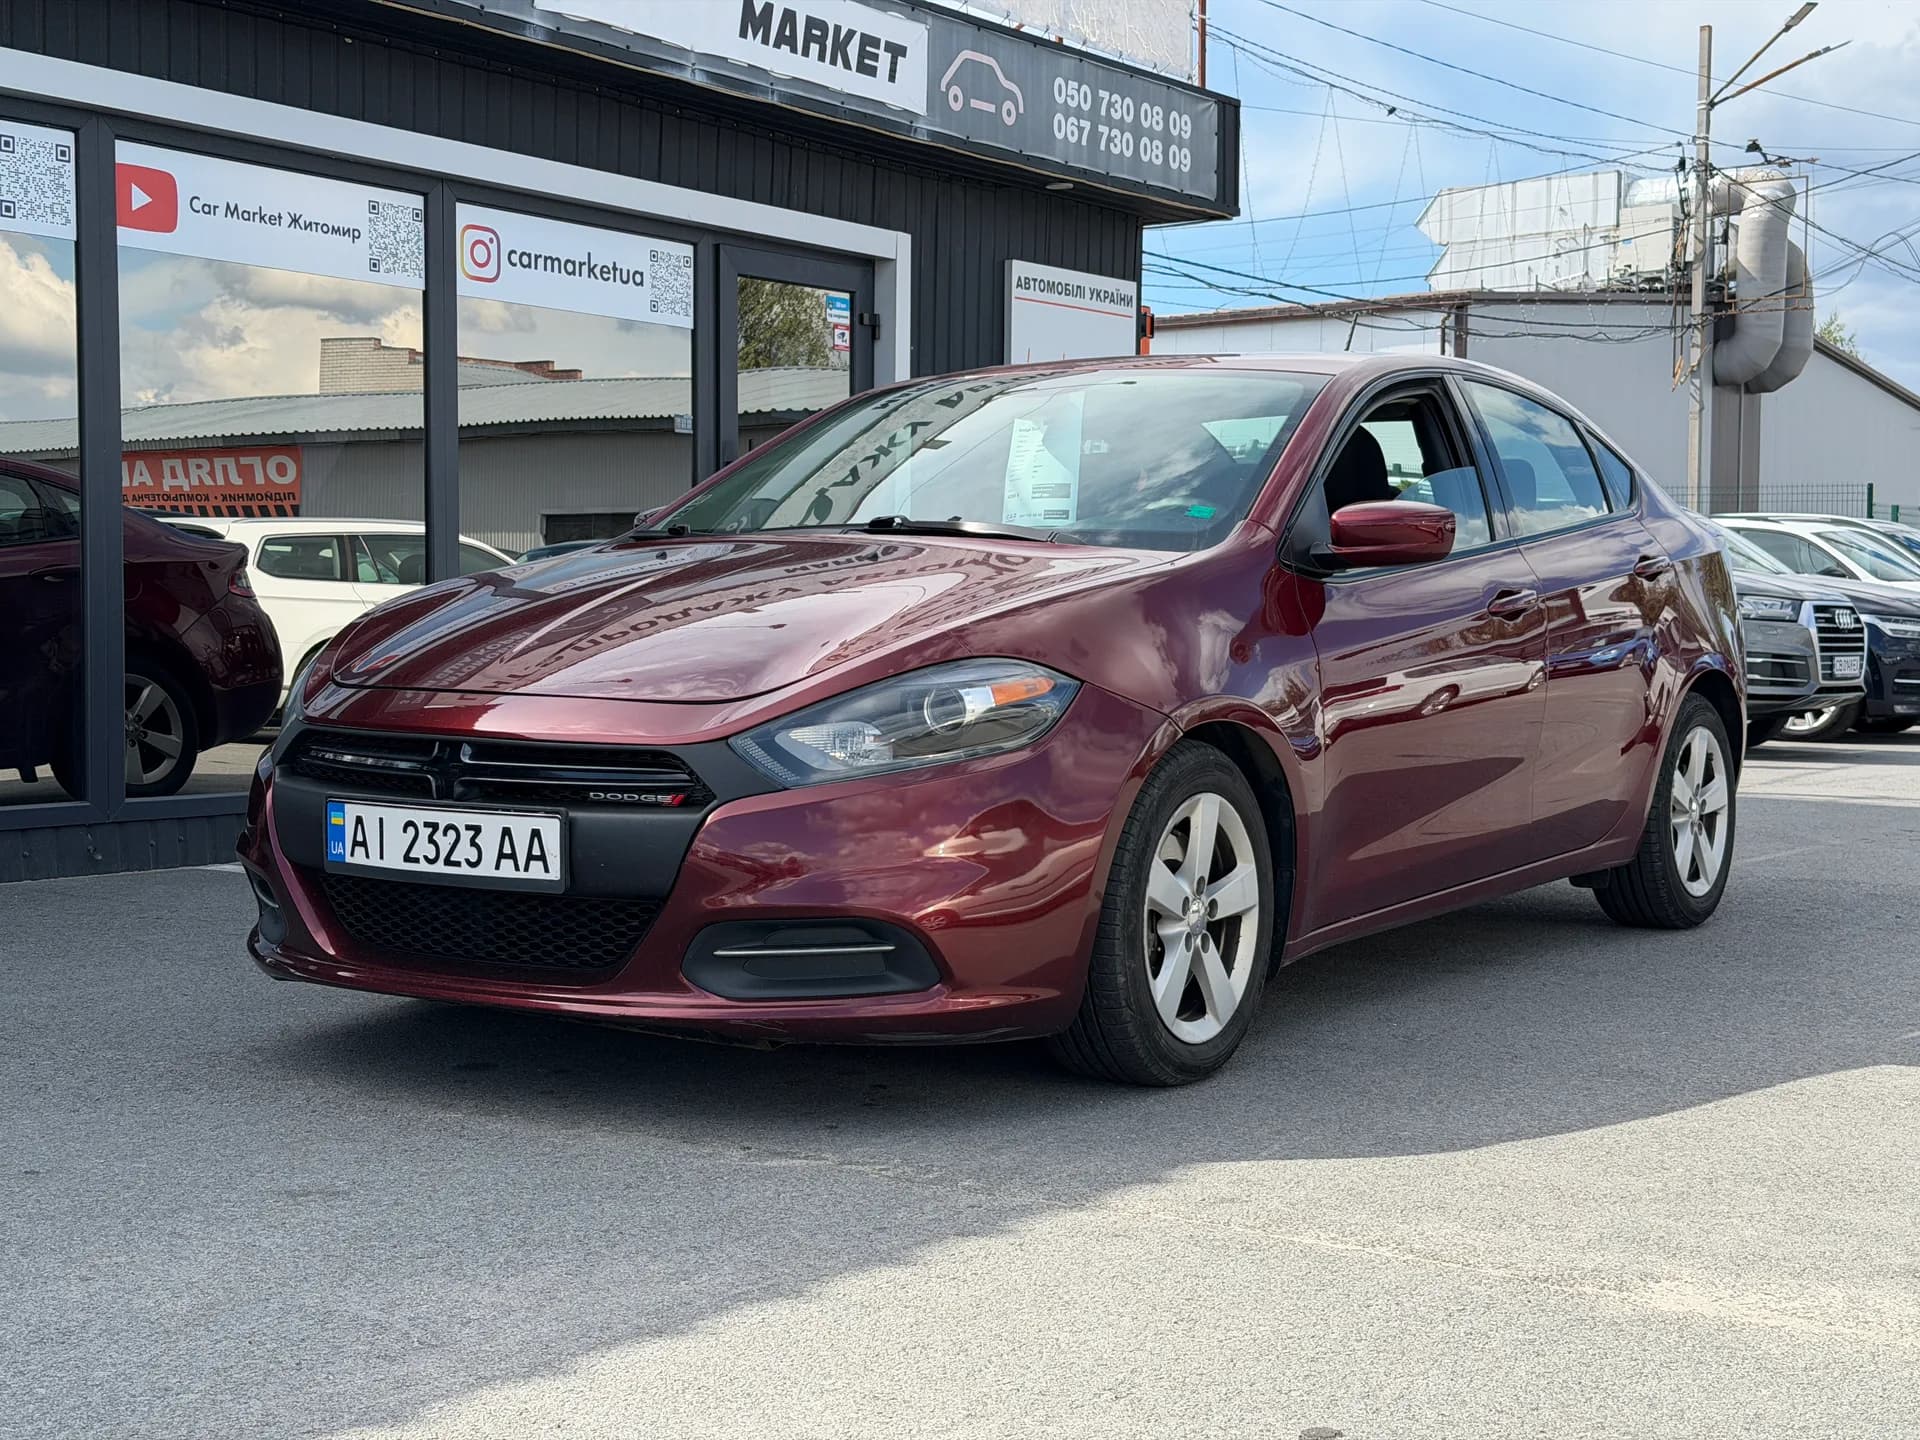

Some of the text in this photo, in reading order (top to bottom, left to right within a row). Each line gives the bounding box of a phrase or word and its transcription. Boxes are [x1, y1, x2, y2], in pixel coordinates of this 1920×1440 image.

[738, 0, 908, 84] MARKET
[1053, 77, 1192, 139] 050 730 08 09
[1053, 112, 1191, 173] 067 730 08 09
[189, 196, 361, 244] Car Market Житомир
[507, 249, 644, 287] carmarketua
[1015, 275, 1133, 308] АВТОМОБІЛІ УКРАЇНИ
[589, 791, 673, 804] DODGE
[331, 841, 344, 856] UA
[350, 815, 551, 874] AI 2323 AA
